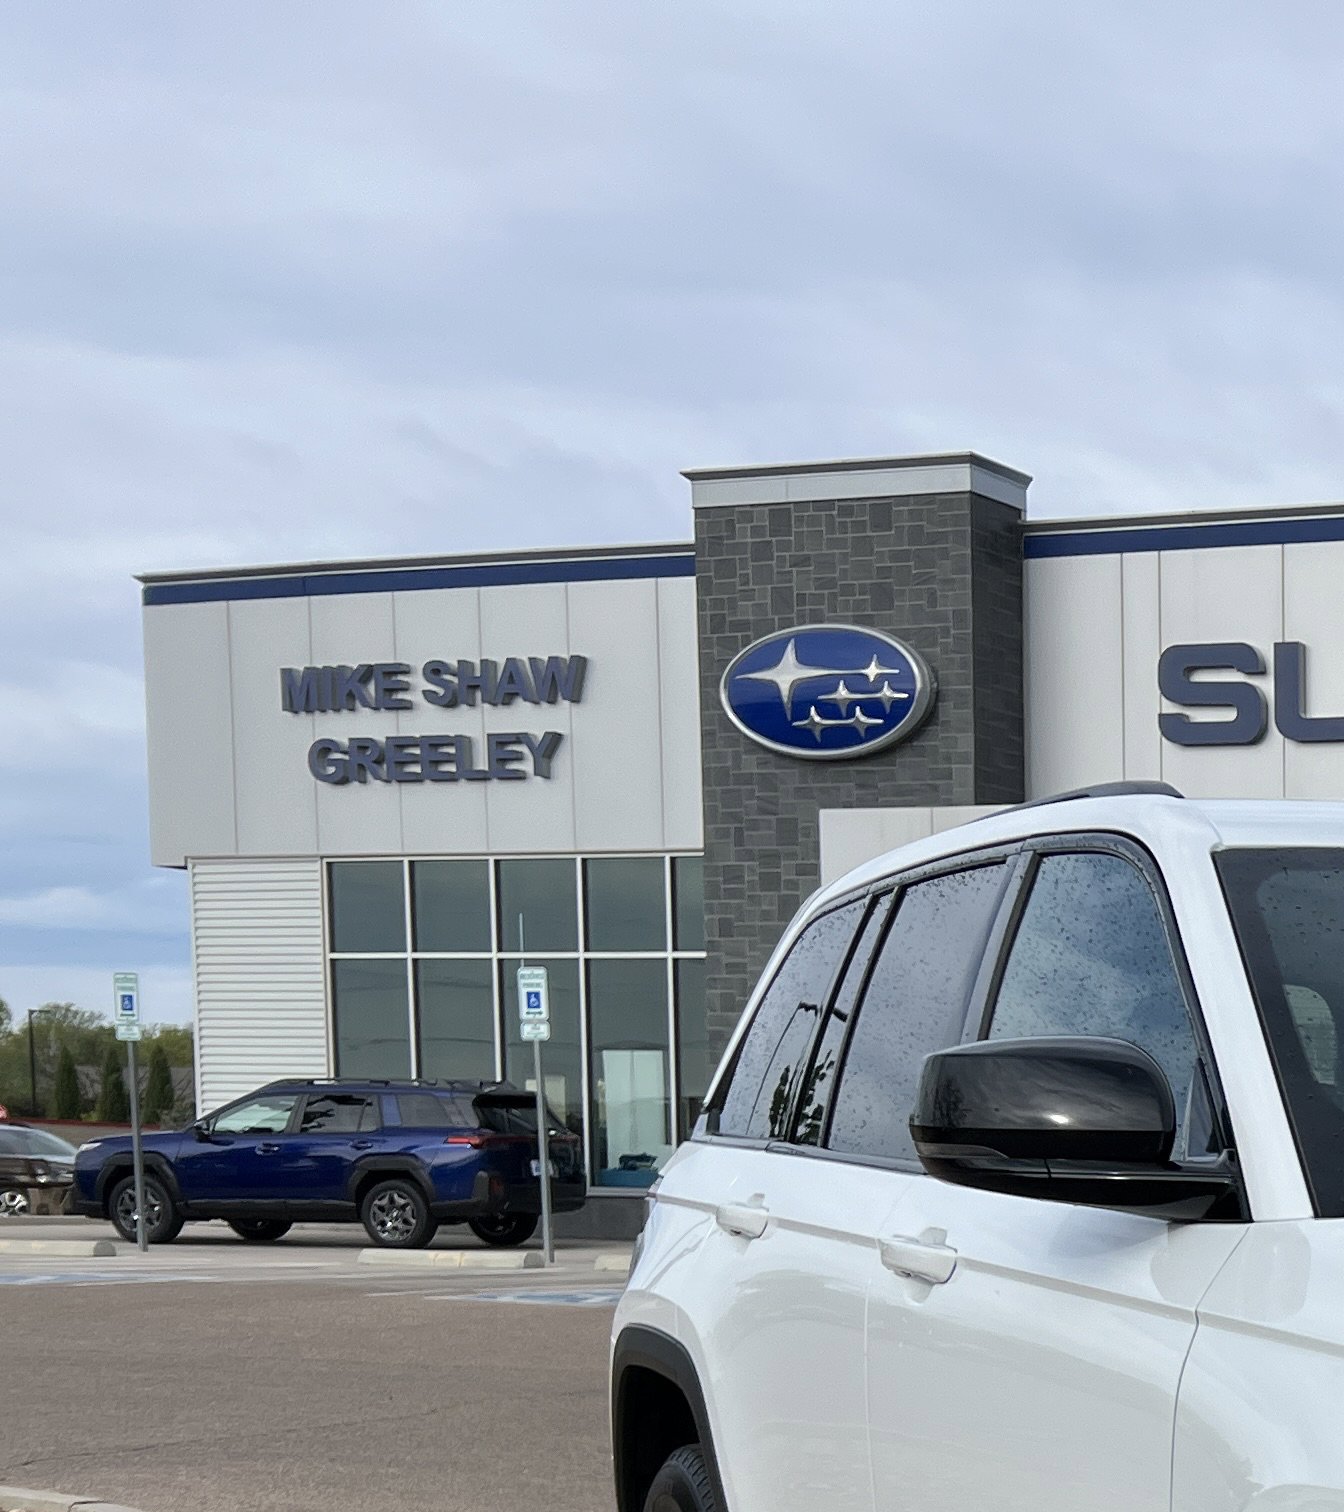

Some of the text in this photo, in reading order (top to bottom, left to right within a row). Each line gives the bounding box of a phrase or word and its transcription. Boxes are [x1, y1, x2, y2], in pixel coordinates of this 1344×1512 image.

[280, 654, 588, 713] MIKE SHAW
[308, 731, 564, 785] GREELEY
